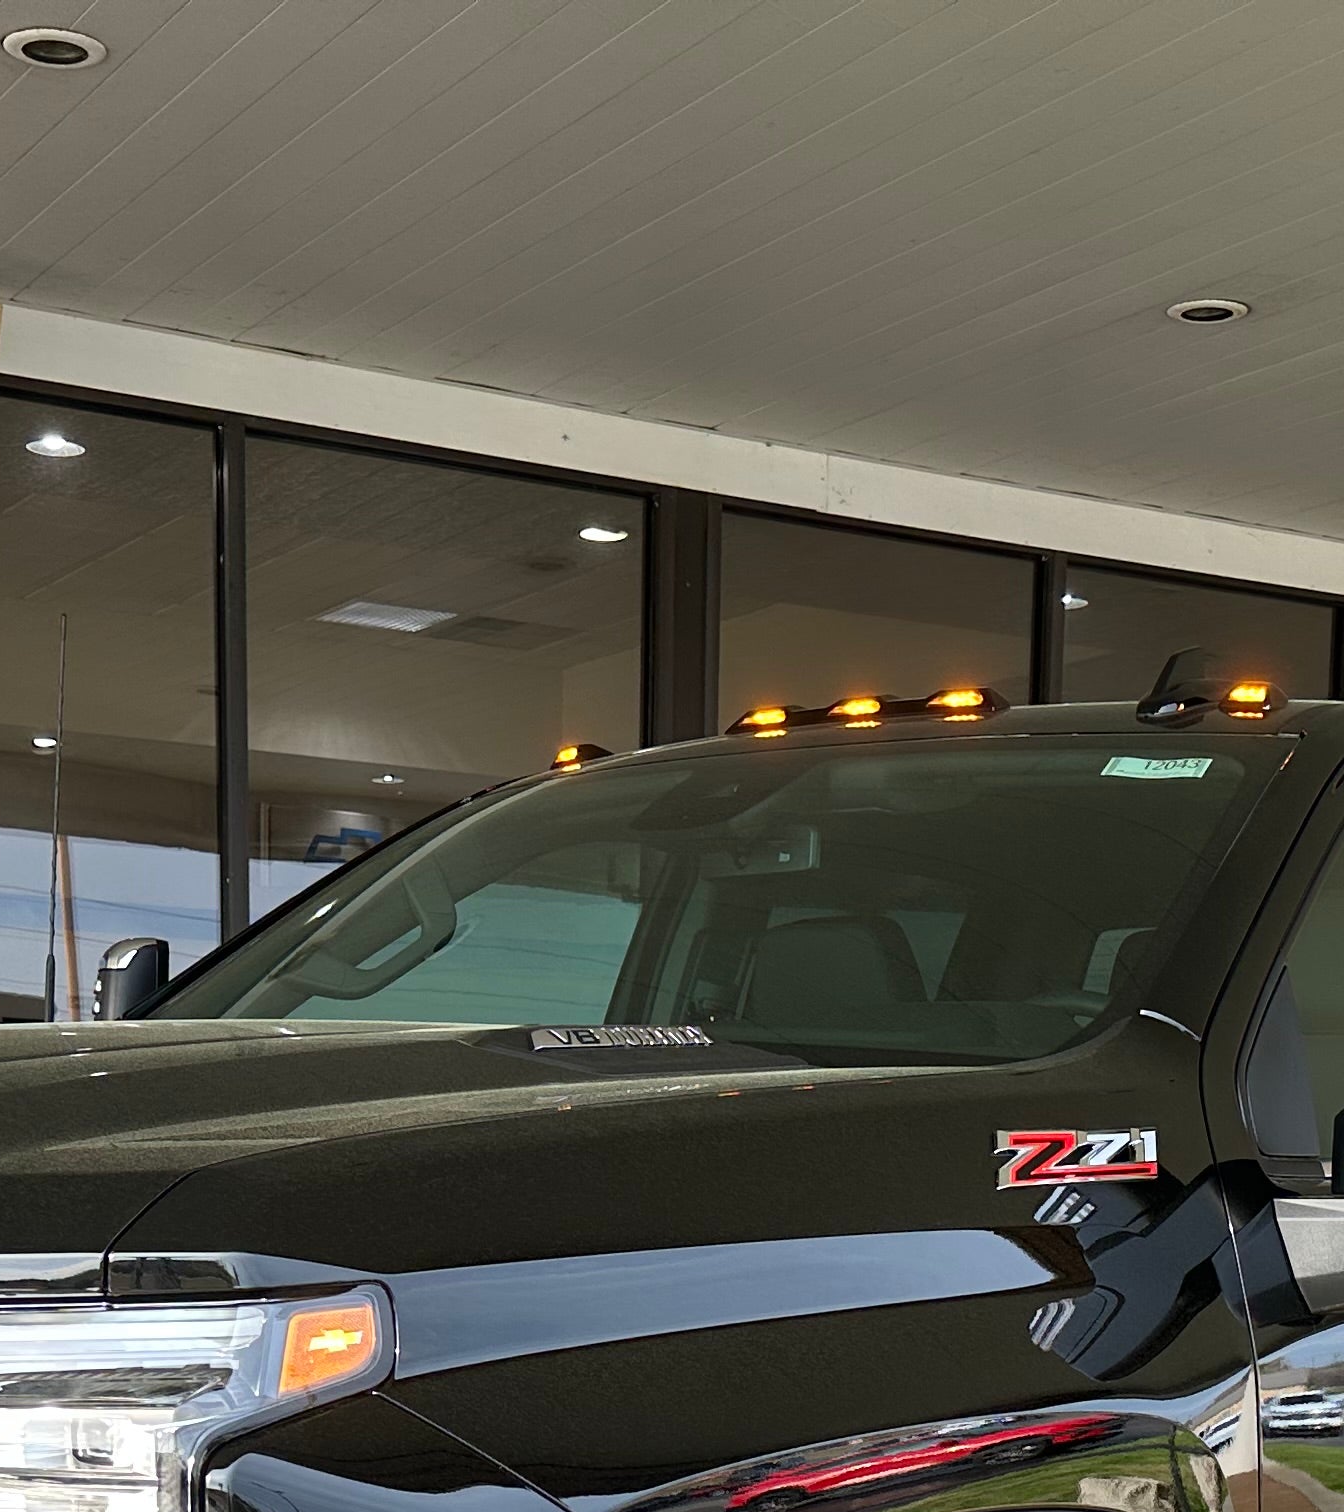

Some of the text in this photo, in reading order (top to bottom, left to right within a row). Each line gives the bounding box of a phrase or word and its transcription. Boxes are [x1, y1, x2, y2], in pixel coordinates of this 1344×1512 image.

[1144, 759, 1202, 770] 12043
[547, 1027, 601, 1045] V8
[993, 1128, 1158, 1190] Z71
